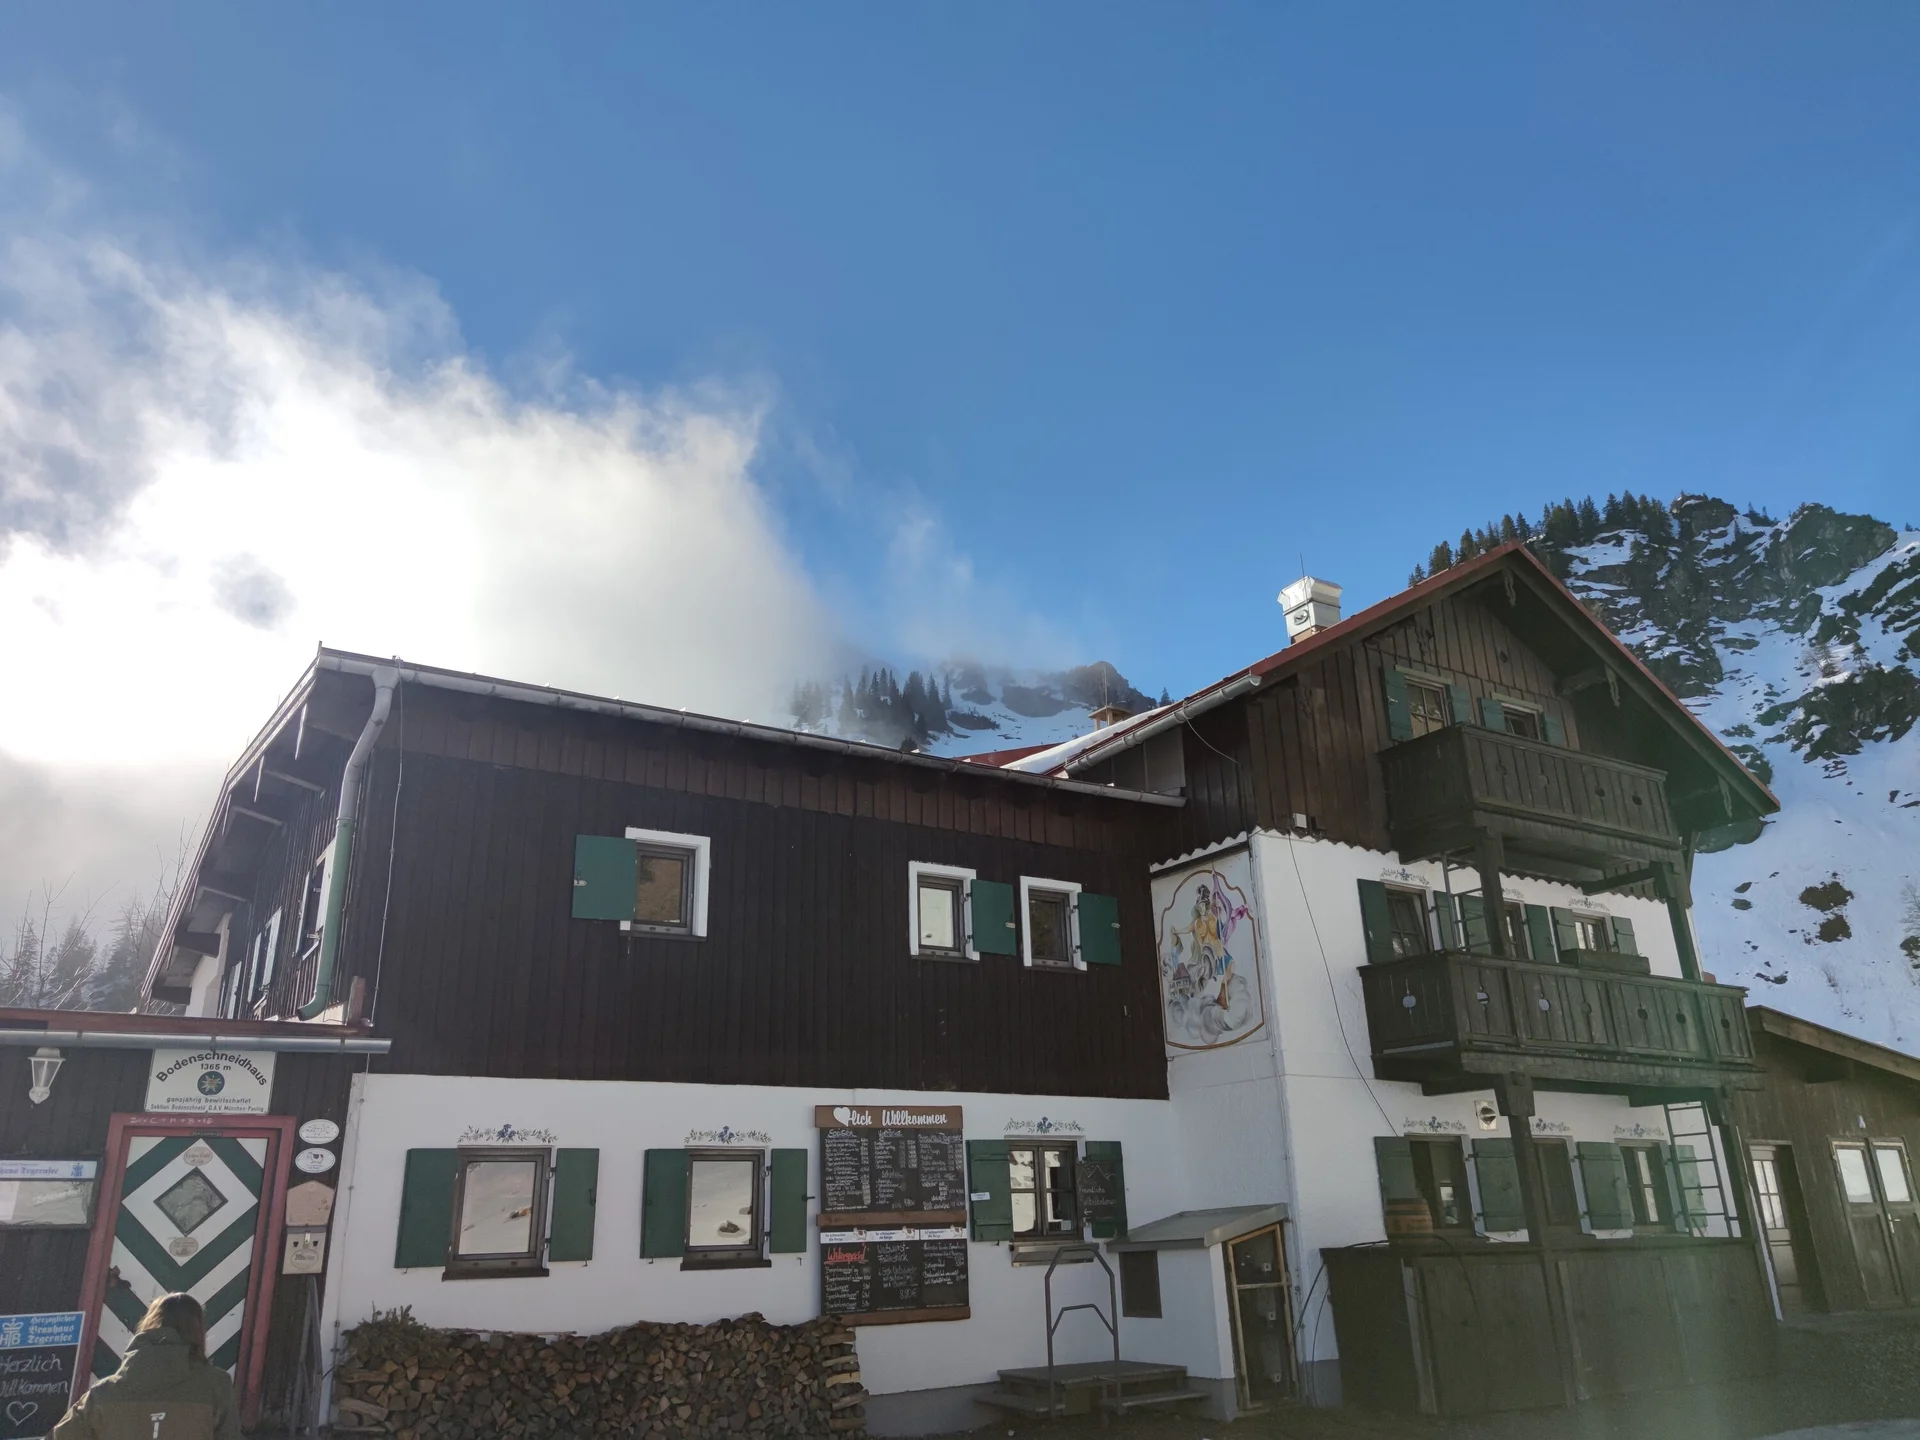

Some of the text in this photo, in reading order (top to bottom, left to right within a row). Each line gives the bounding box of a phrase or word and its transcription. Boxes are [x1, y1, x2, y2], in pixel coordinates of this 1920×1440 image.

[156, 1051, 267, 1086] Bodenschneidhaus
[882, 1110, 948, 1127] Willkommen
[28, 1324, 75, 1334] Brauhaus
[27, 1334, 73, 1345] Tegernsee
